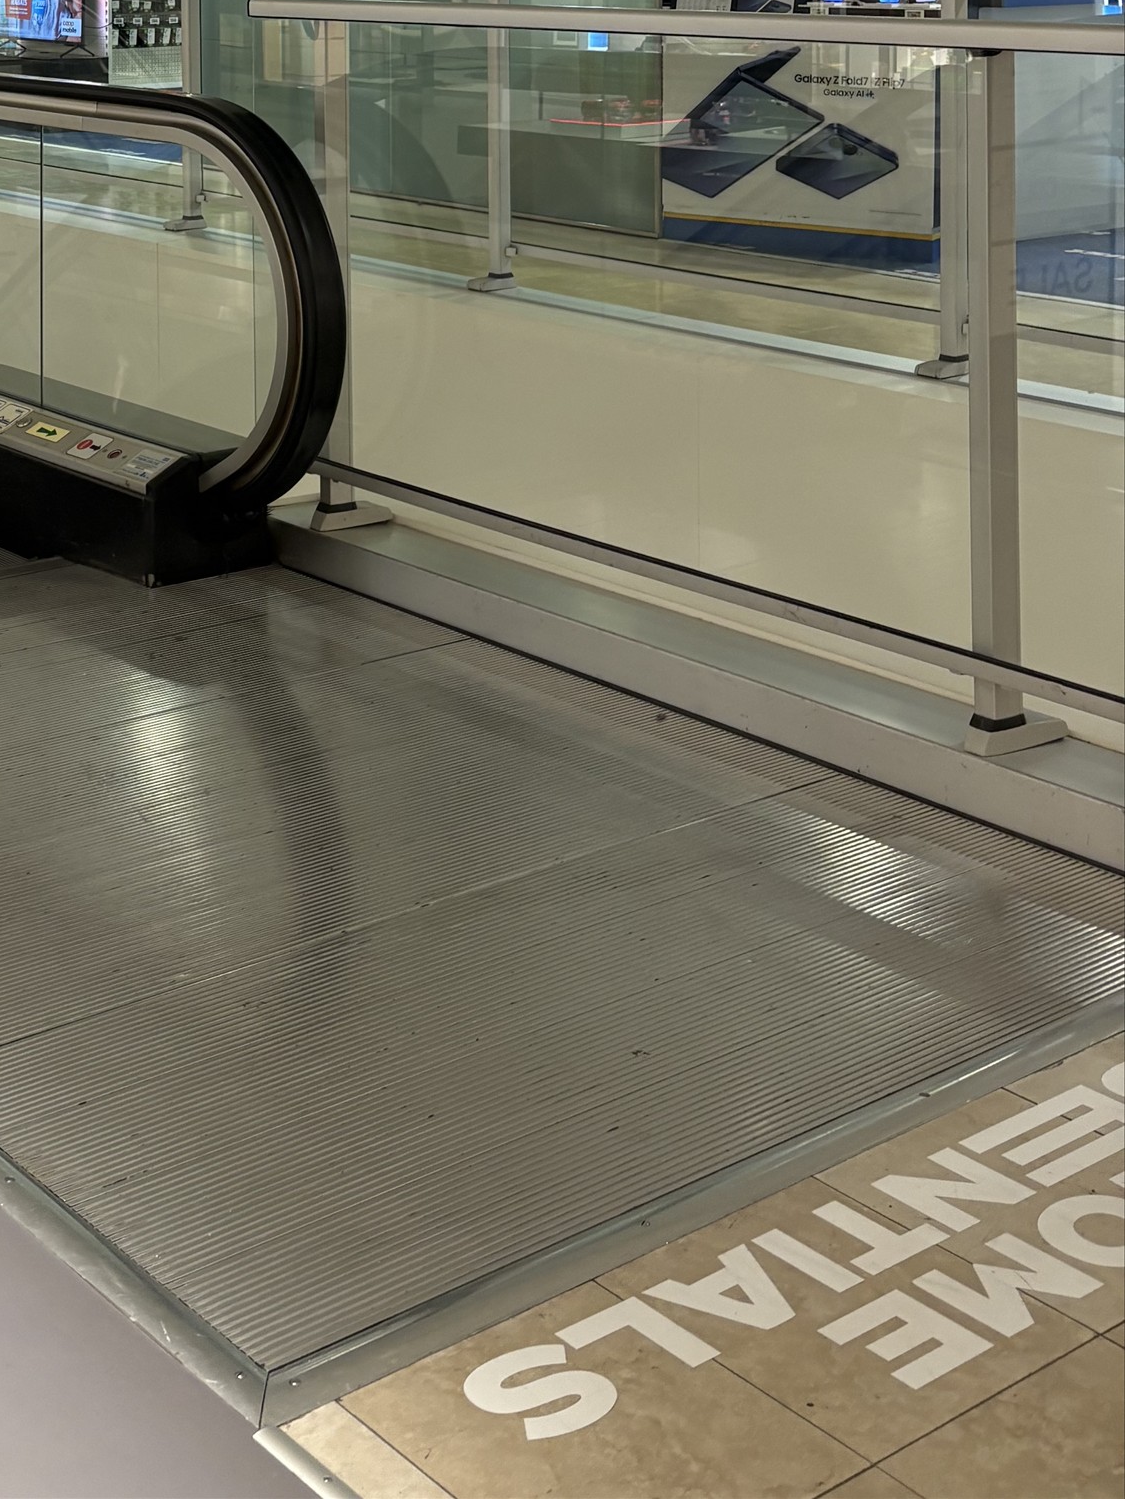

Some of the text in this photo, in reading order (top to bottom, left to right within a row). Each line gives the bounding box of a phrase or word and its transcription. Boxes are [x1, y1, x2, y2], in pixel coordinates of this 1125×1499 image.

[794, 74, 832, 85] Galaxy
[833, 76, 839, 84] Z
[841, 76, 868, 85] Fold7
[823, 89, 854, 98] Galaxy
[463, 1061, 1125, 1441] ENTIALS
[817, 1180, 1125, 1390] OME
